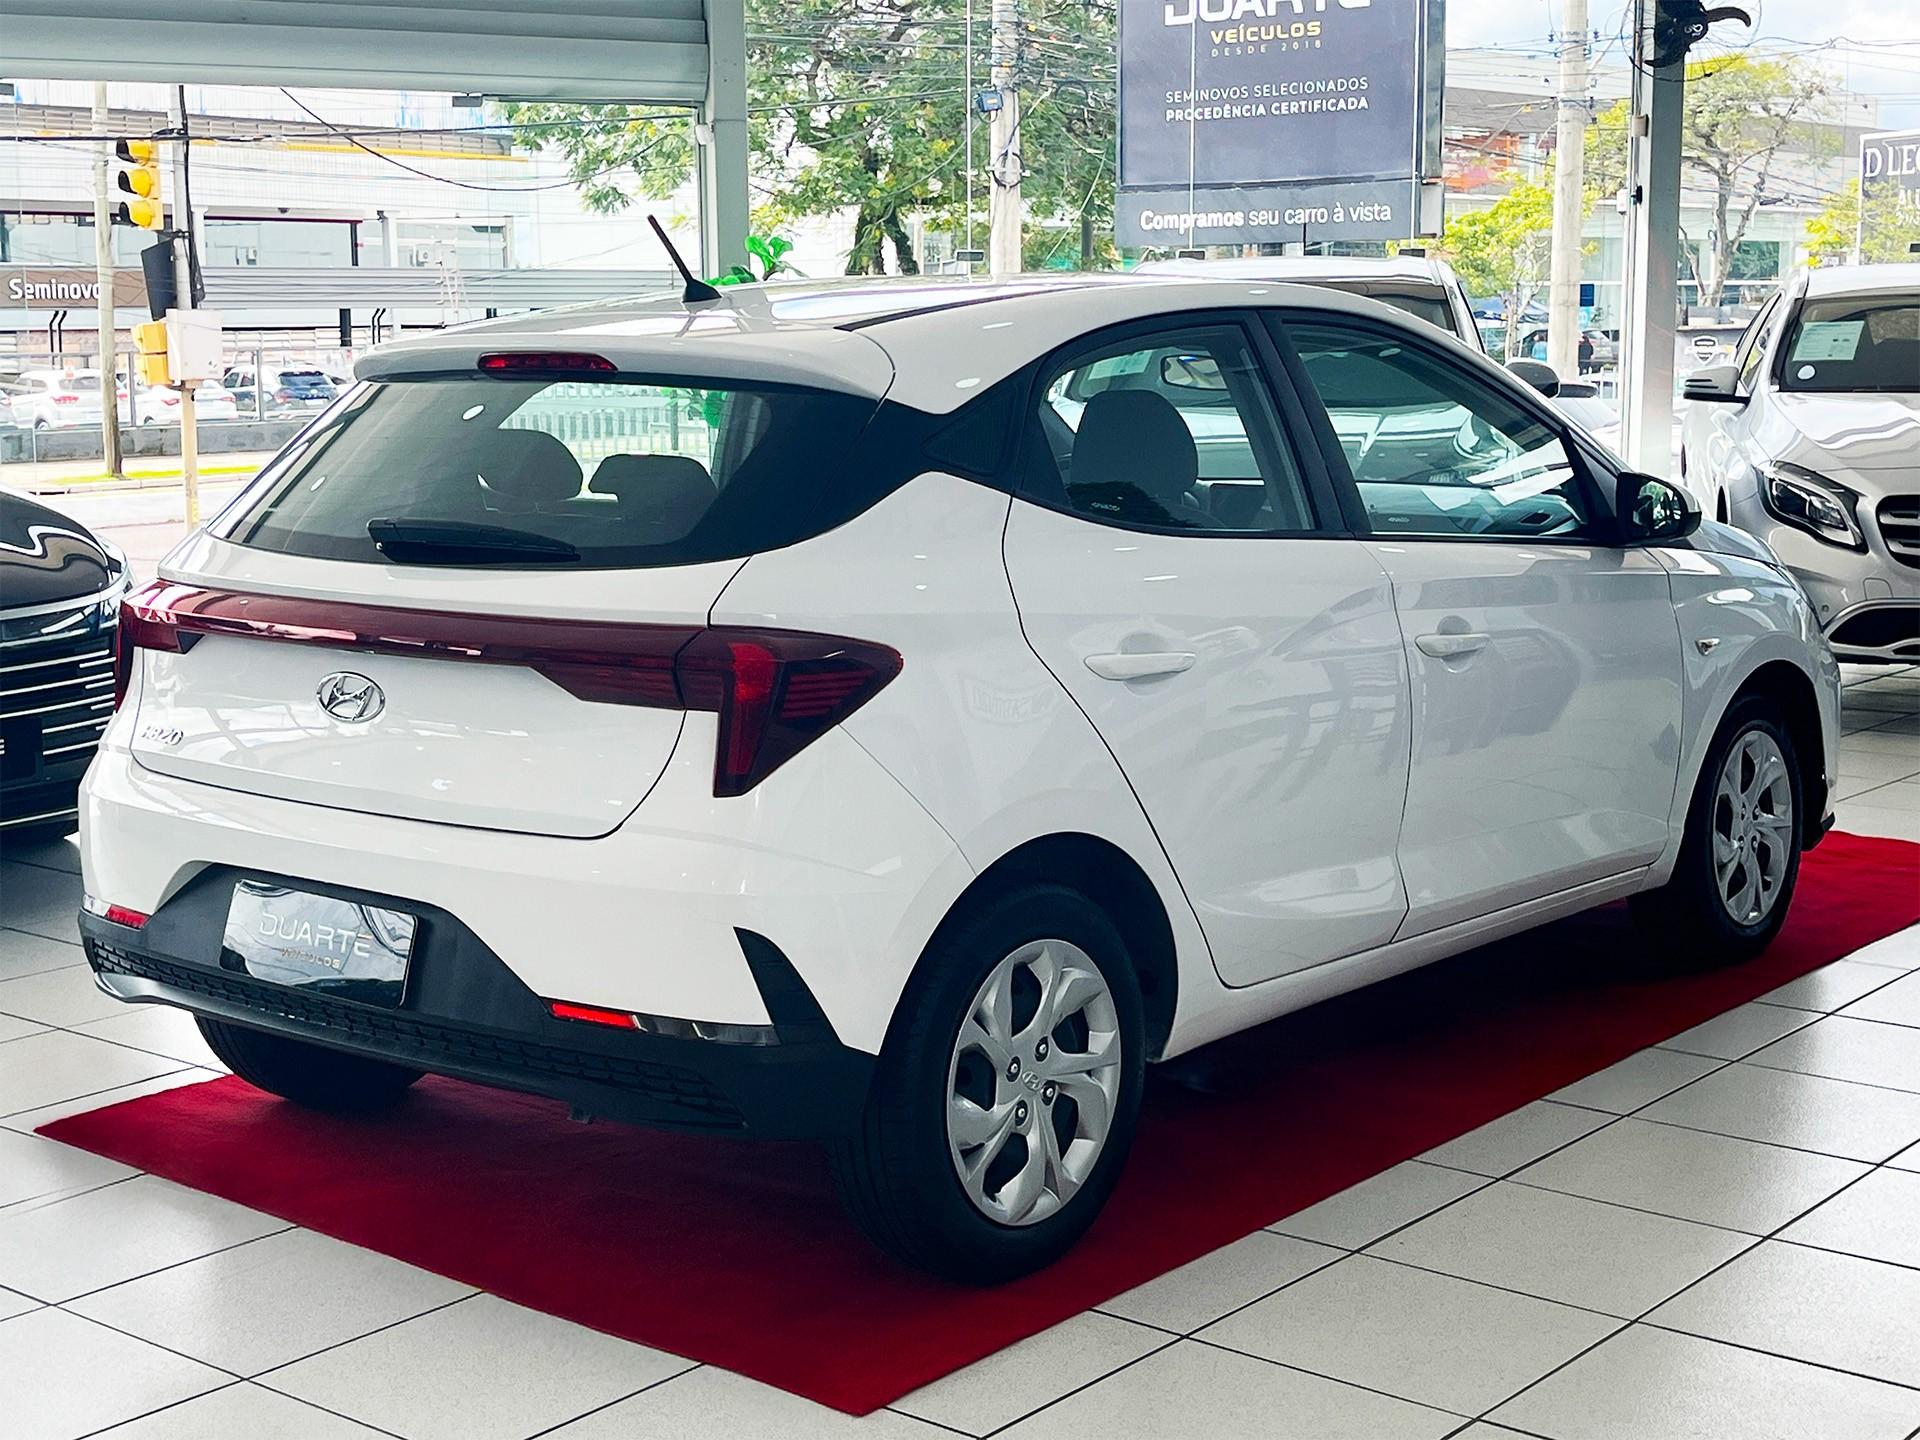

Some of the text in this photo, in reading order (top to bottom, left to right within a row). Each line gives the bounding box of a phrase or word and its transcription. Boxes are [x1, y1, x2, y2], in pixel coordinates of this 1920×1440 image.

[1210, 20, 1322, 45] VEÍCULOS
[1211, 40, 1322, 58] DESDE 2018
[1165, 76, 1369, 104] SEMINOVOS SELECIONADOS
[1165, 96, 1369, 122] PROCEDÊNCIA CERTIFICADA
[1140, 201, 1392, 234] Compramos seu carro à vista
[260, 911, 373, 959] DUARTE
